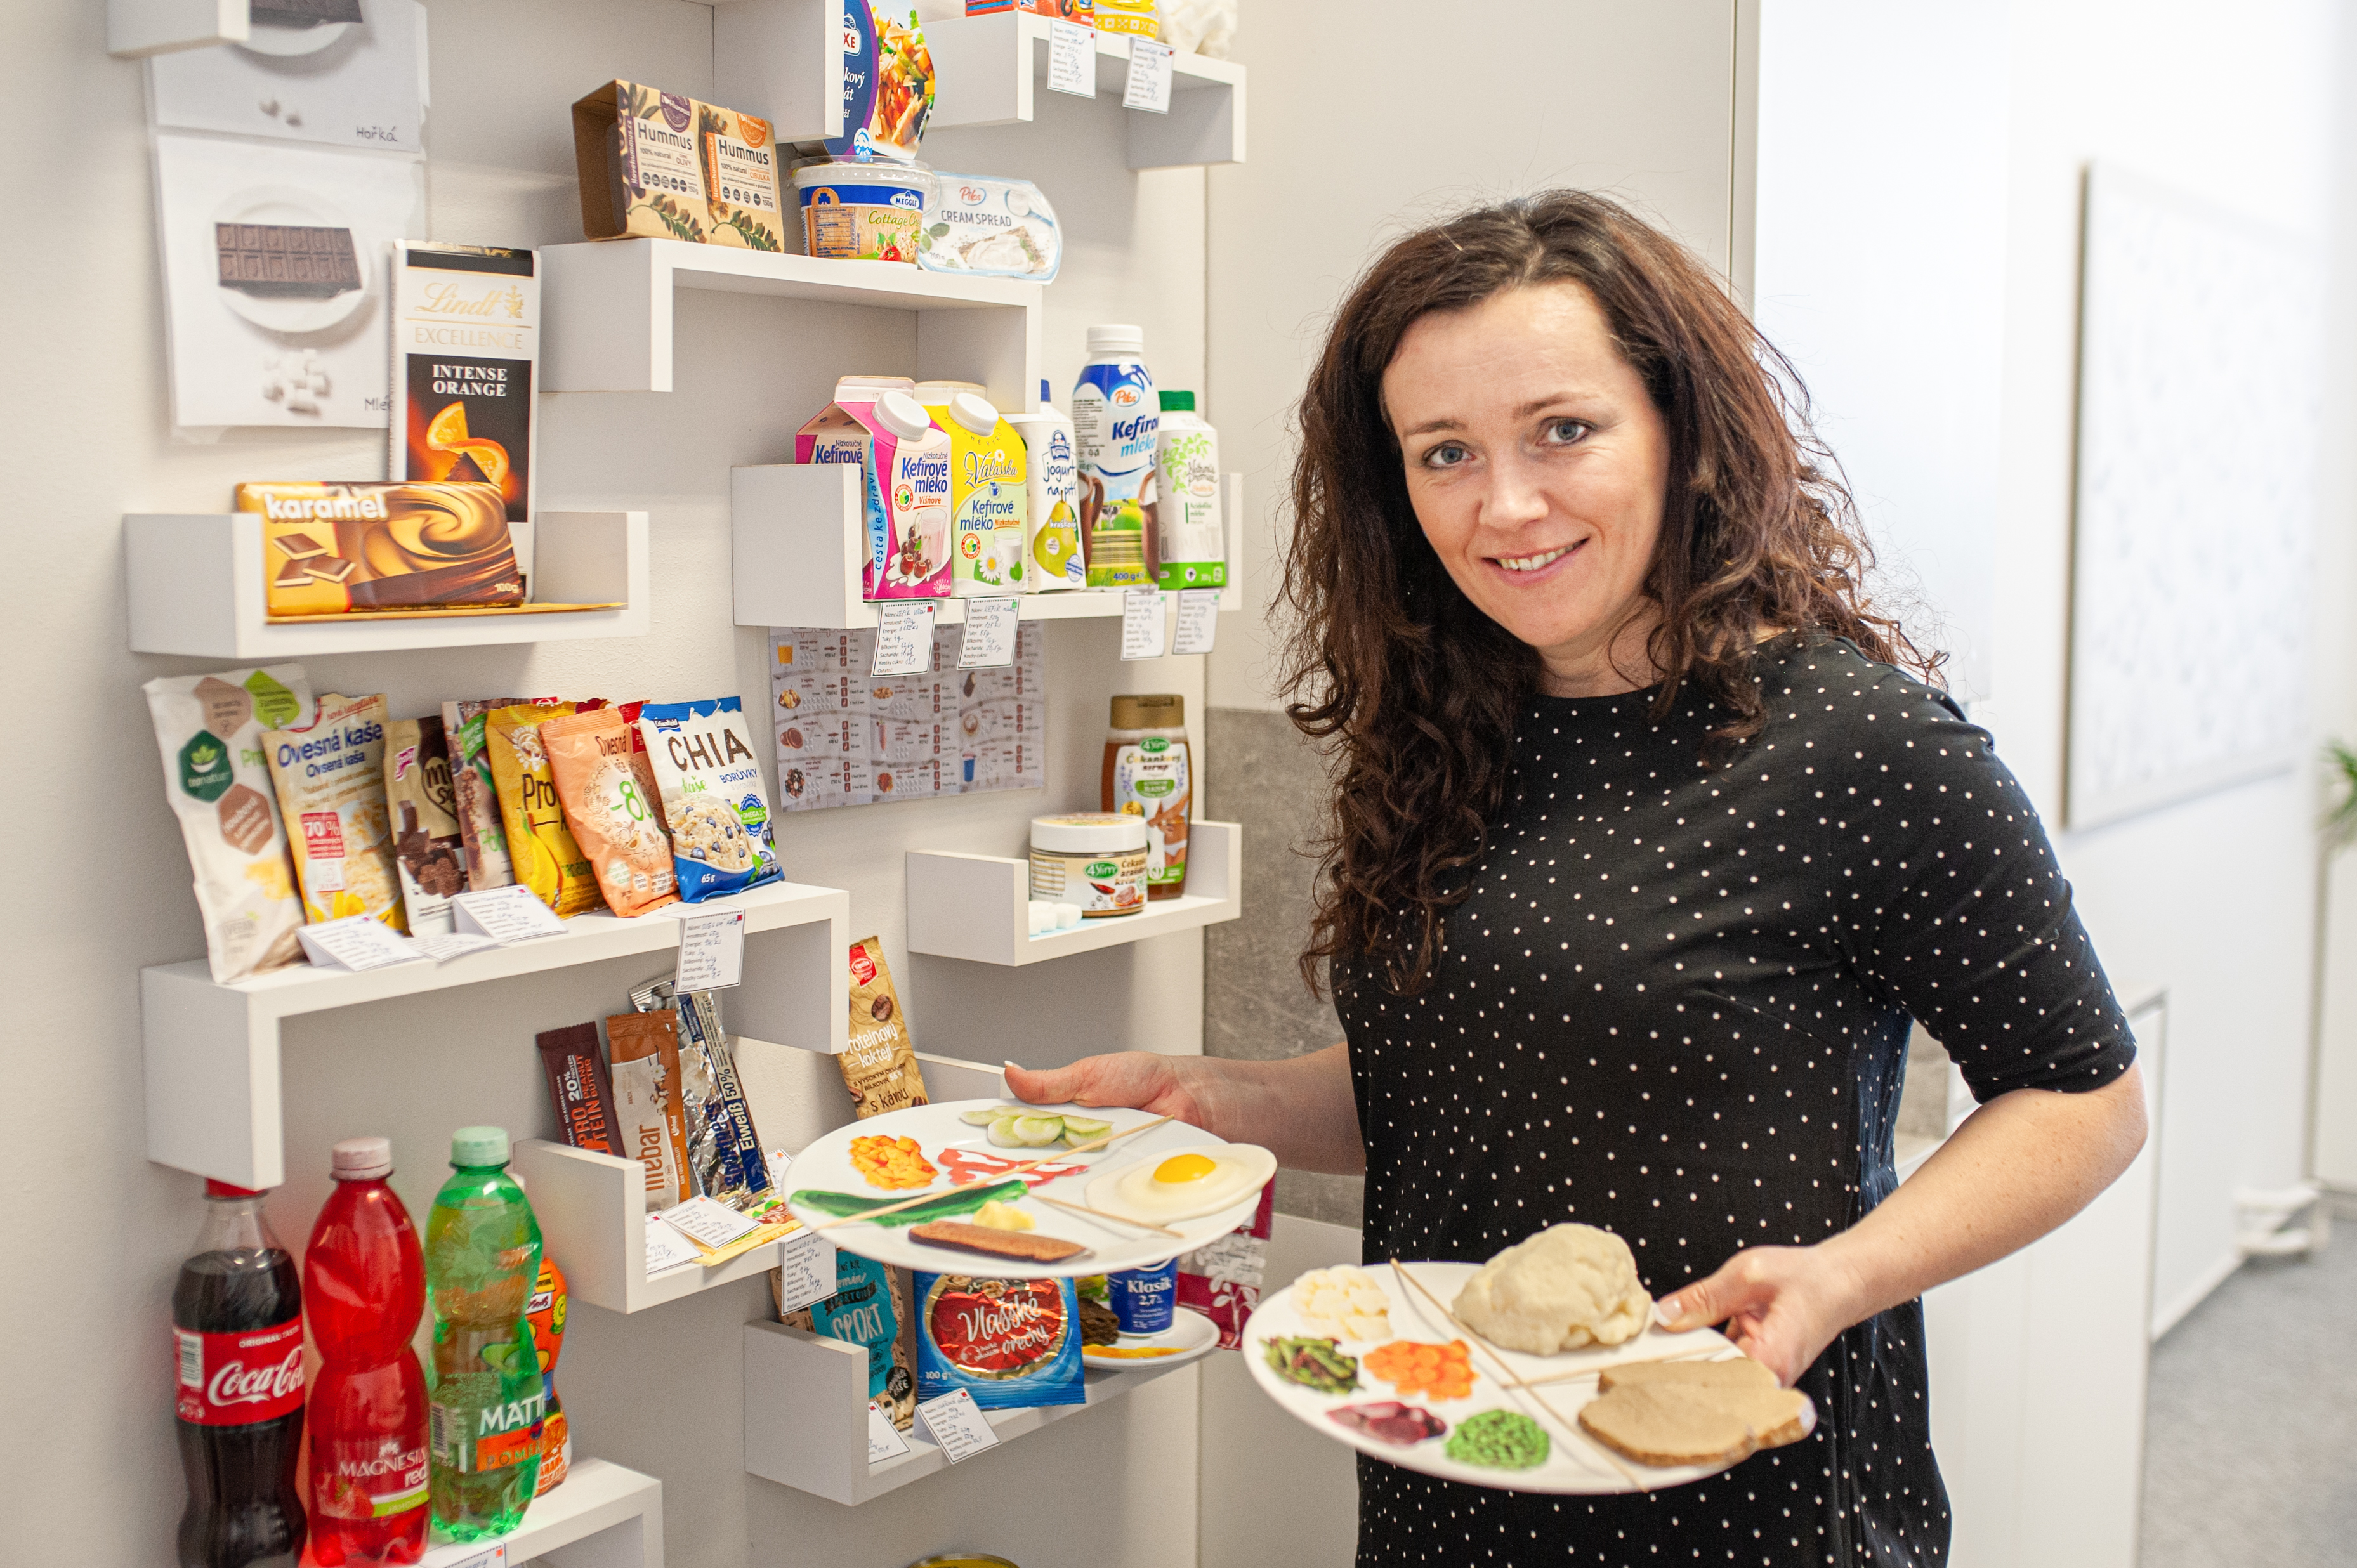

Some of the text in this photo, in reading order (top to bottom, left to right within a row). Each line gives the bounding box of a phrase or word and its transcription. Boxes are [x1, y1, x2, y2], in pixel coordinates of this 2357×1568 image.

[844, 67, 865, 89] kový
[357, 126, 398, 142] Hořká
[638, 122, 692, 150] Hummus
[718, 139, 769, 166] Hummus
[895, 197, 917, 207] MEGGLE
[869, 210, 908, 229] Cottage
[941, 210, 1011, 227] CREAM SPREAD
[414, 282, 502, 317] Lindt
[415, 327, 523, 350] EXCELLENCE
[432, 364, 508, 381] INTENSE
[433, 381, 507, 397] ORANGE
[364, 395, 390, 412] Mlé
[836, 439, 862, 447] Nízkotučné
[815, 445, 863, 464] Kefírové
[923, 452, 948, 460] Nízkotučné
[902, 457, 948, 480] Kefírové
[1042, 462, 1075, 483] jogurt
[914, 476, 948, 493] mléko
[1047, 481, 1077, 502] na pití
[265, 492, 388, 521] karamel
[919, 495, 942, 504] Višňové
[972, 499, 1014, 518] Kefírové
[867, 473, 884, 570] cesta ke zdraví
[960, 516, 1020, 531] mléko Nízkotučné
[1049, 517, 1077, 532] hruškový
[278, 720, 383, 768] Ovesná kaše
[595, 729, 627, 757] Ovesná
[667, 728, 754, 772] CHIA
[306, 757, 343, 778] Ovsená
[719, 768, 758, 784] BORŮVKY
[522, 773, 556, 811] Pro
[681, 774, 709, 795] kaše
[305, 821, 325, 837] 70
[1087, 864, 1116, 877] 4Slim
[858, 1043, 893, 1068] koktejl
[575, 1054, 591, 1099] PEANUT
[584, 1058, 598, 1098] BUTTER
[718, 1068, 737, 1098] 50%
[858, 1071, 885, 1085] VYSOKÝM
[870, 1087, 909, 1113] s kávou
[571, 1106, 591, 1146] PRO
[585, 1099, 608, 1142] TEIN
[728, 1101, 756, 1151] Eiweiß
[1127, 1277, 1172, 1293] Klasik
[832, 1303, 884, 1344] SPORT
[957, 1291, 1042, 1342] Vlašské
[239, 1333, 281, 1349] ORIGINAL
[1002, 1324, 1051, 1355] ořechy
[926, 1371, 940, 1380] 100
[338, 1446, 426, 1477] MAGNESIA
[405, 1461, 428, 1487] red
